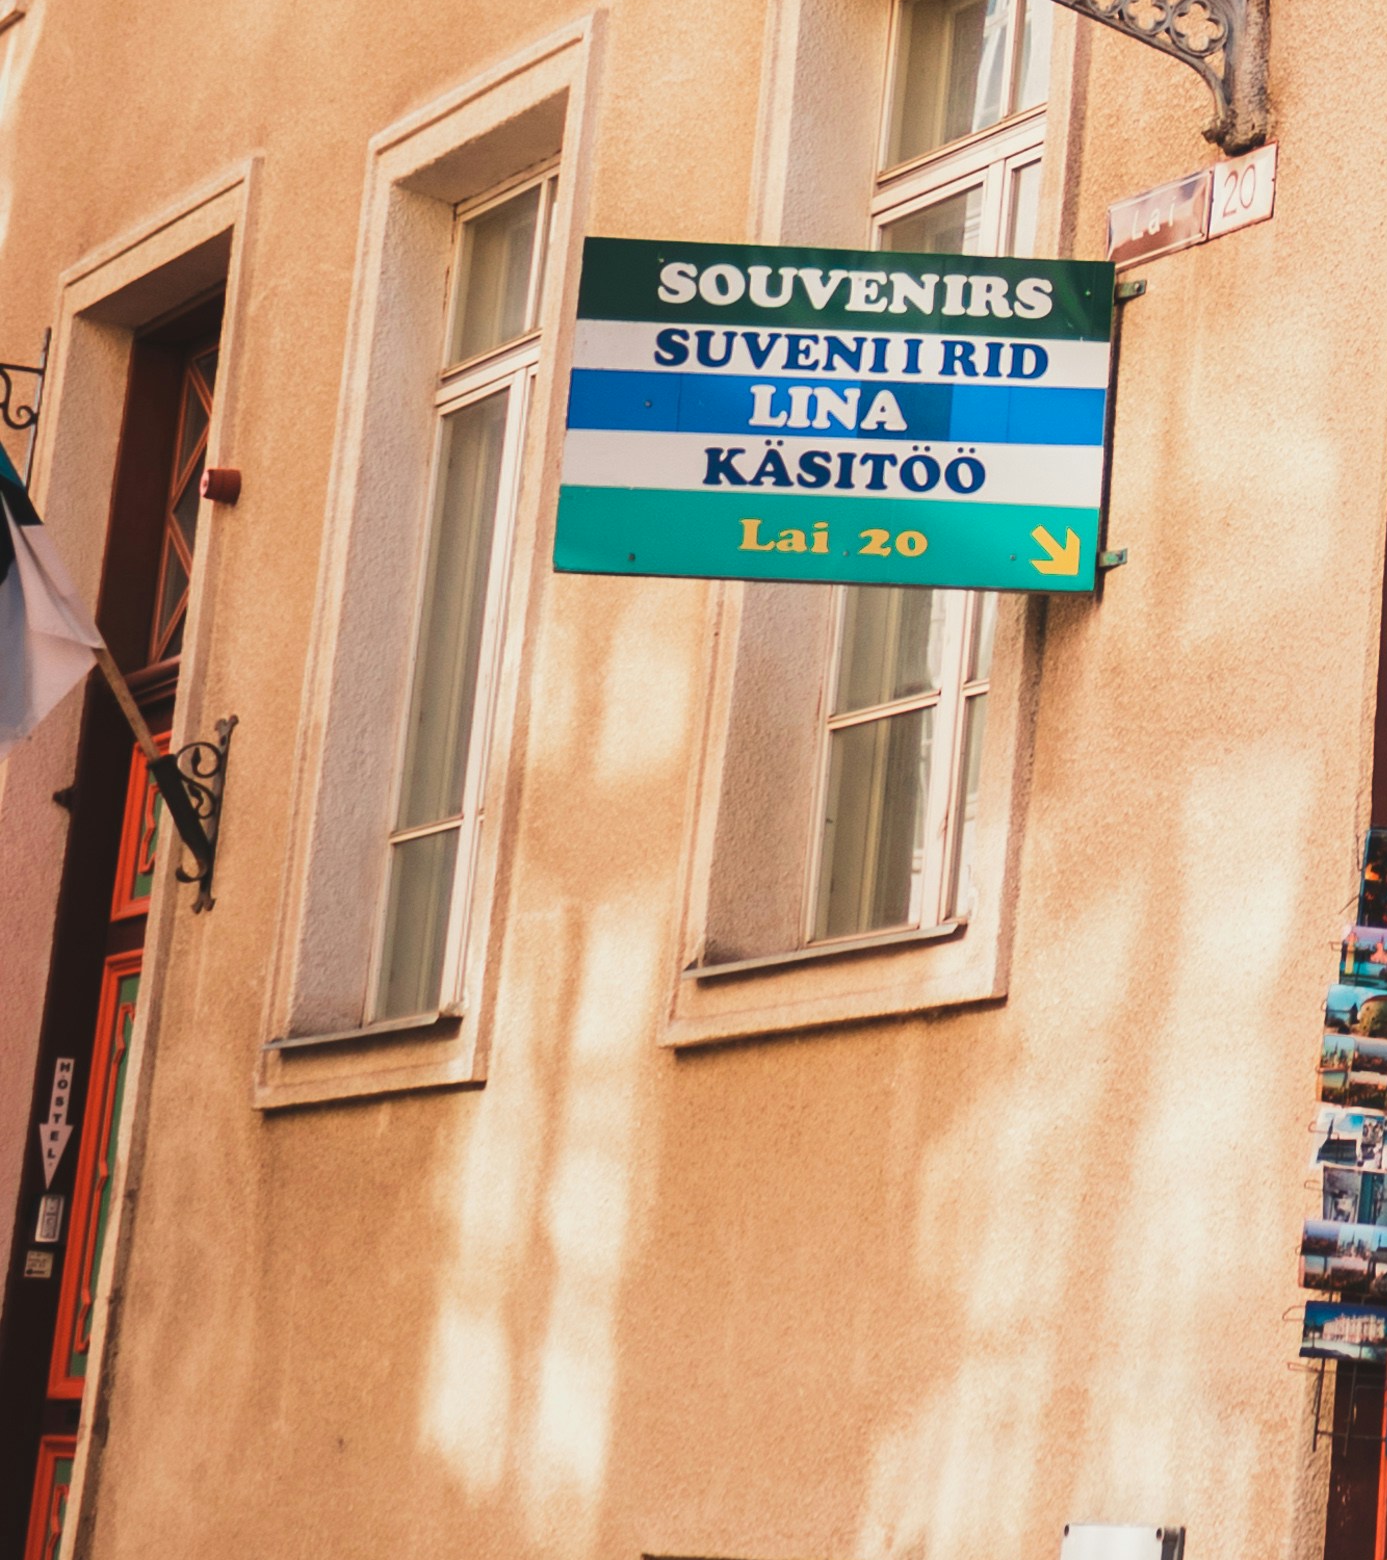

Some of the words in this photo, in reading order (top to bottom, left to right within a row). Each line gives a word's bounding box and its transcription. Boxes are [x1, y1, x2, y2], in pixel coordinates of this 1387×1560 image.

[1132, 196, 1177, 241] Lai
[1222, 164, 1257, 218] 20
[657, 261, 1053, 320] SOUVENIRS
[654, 327, 1049, 380] SUVENIIRID
[749, 385, 907, 432] LINA
[702, 439, 987, 495] KÄSITÖÖ
[738, 517, 830, 555] Lai
[859, 529, 929, 558] 20
